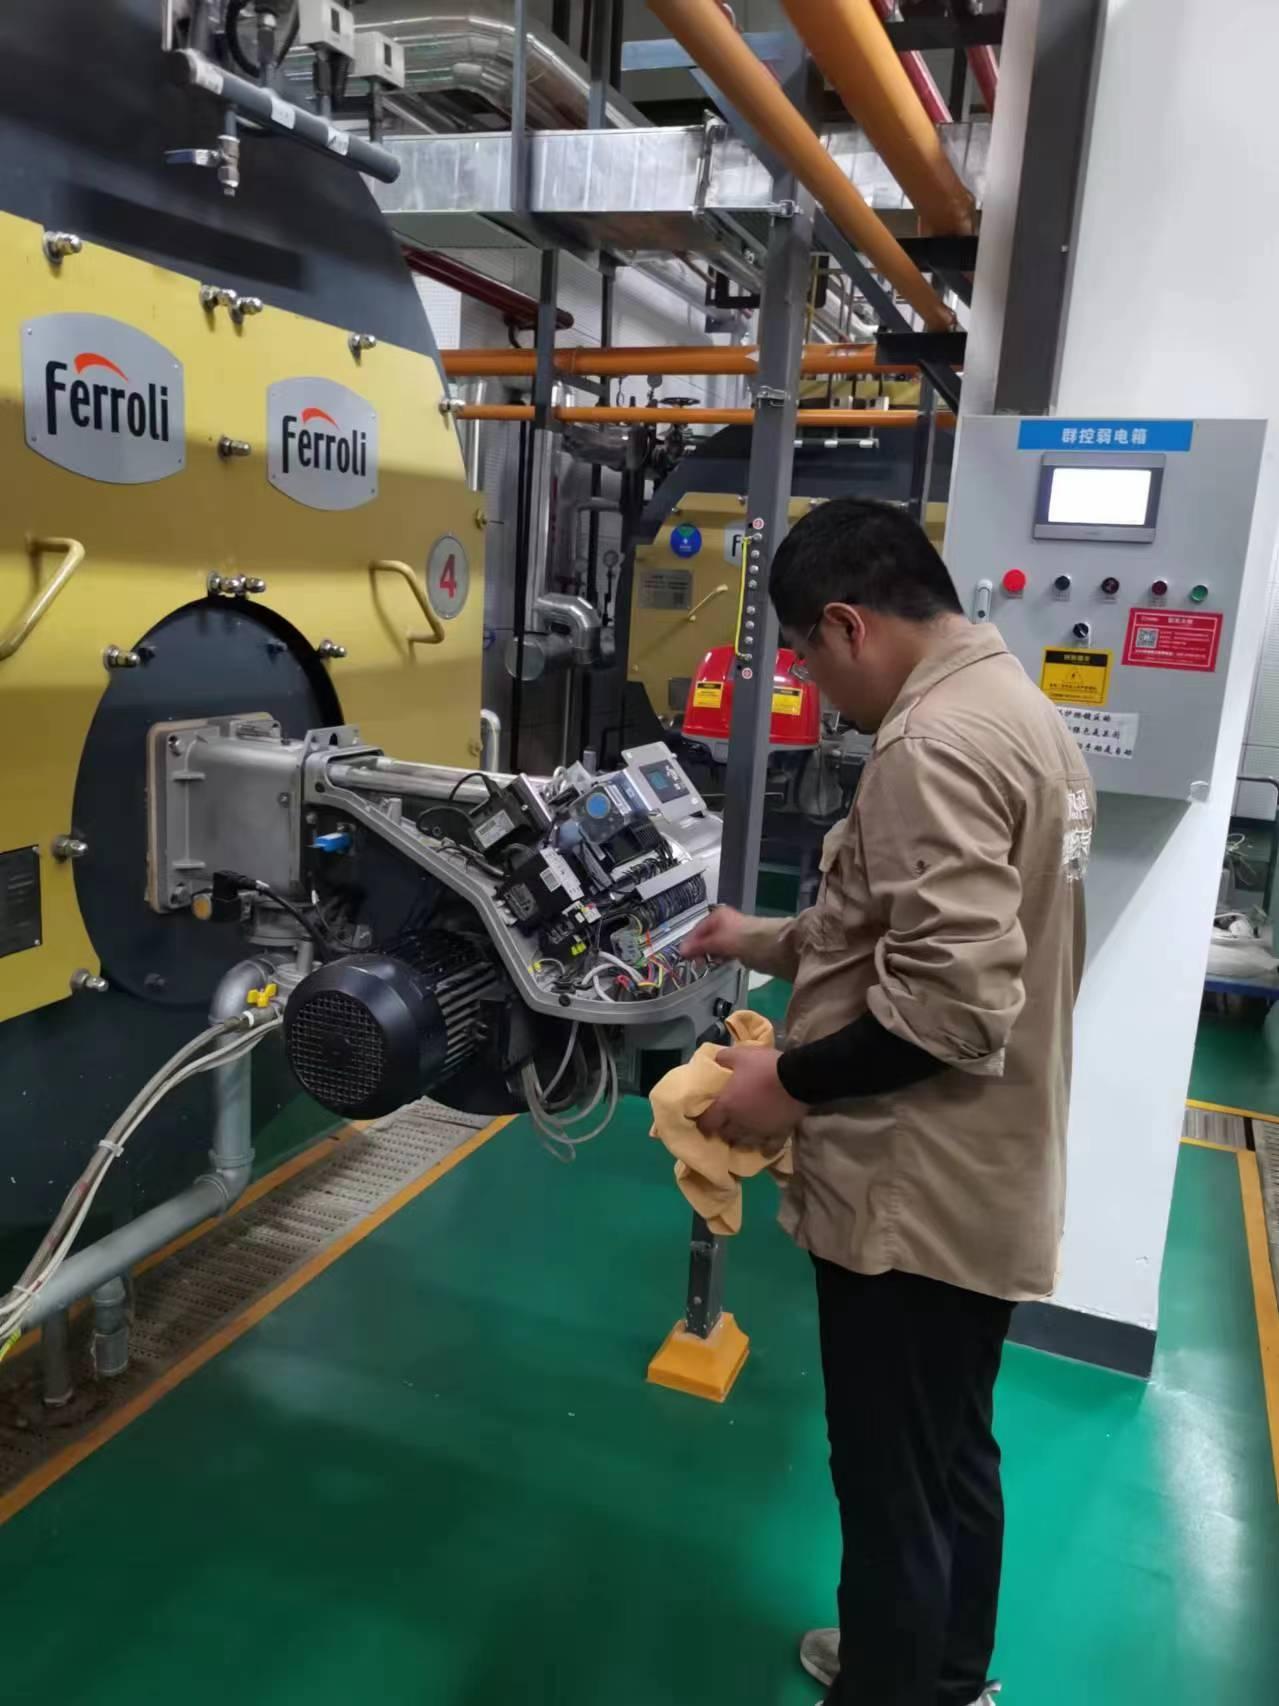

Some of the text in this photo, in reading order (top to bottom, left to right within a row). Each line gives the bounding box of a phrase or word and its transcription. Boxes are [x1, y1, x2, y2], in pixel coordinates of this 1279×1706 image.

[45, 360, 169, 442] Ferroli
[282, 414, 366, 477] Ferroli
[1062, 427, 1148, 445] 群控弱电箱
[439, 553, 457, 599] 4
